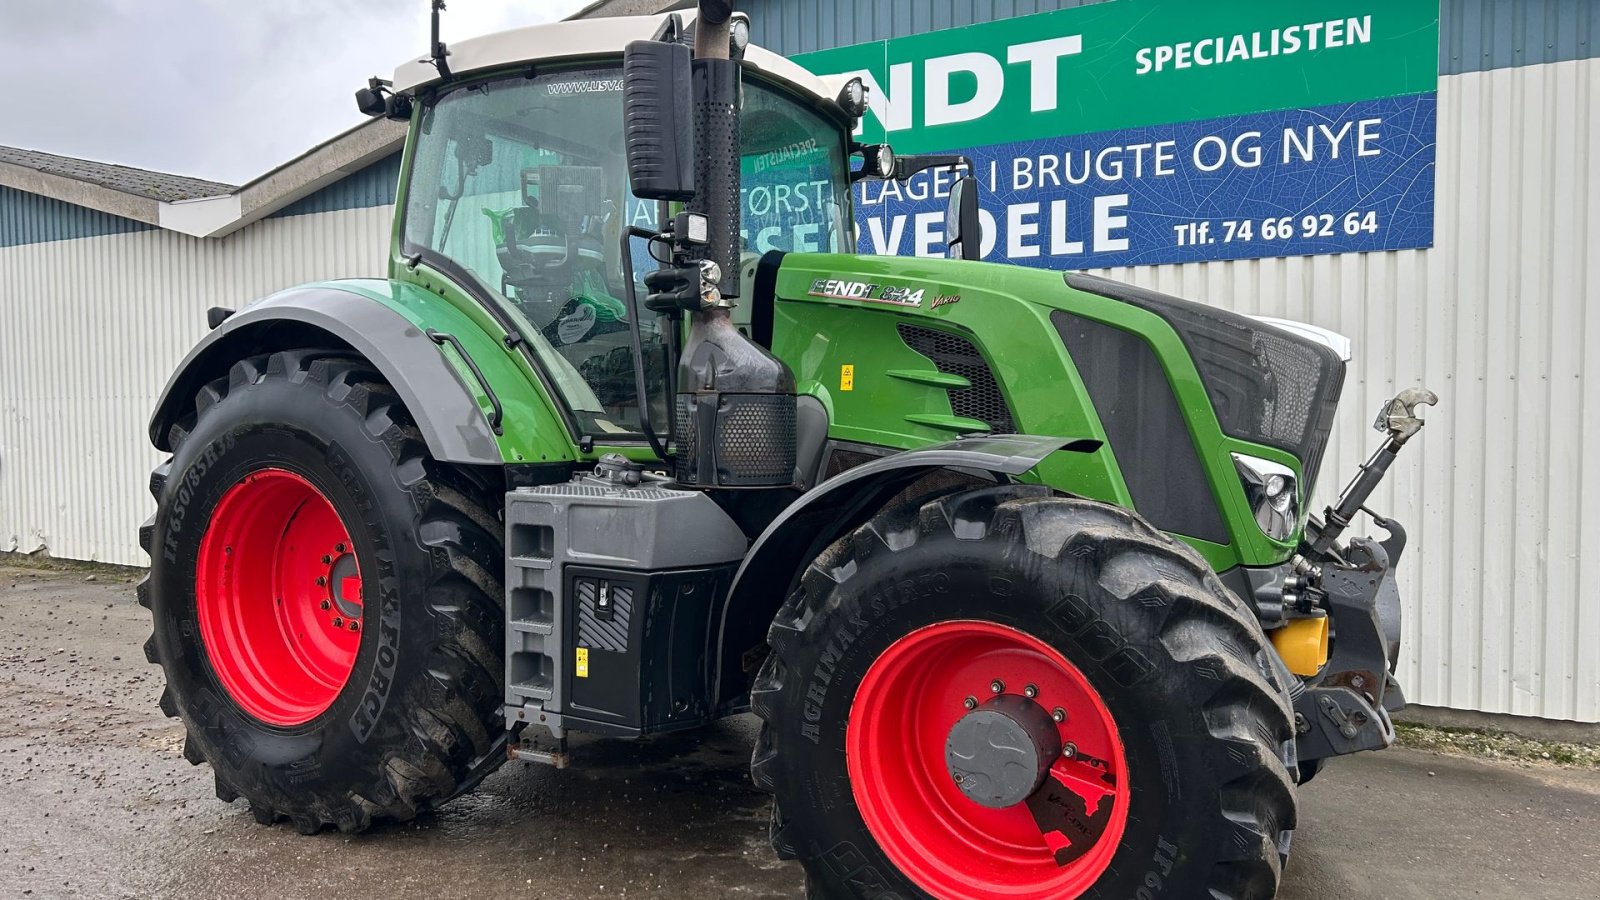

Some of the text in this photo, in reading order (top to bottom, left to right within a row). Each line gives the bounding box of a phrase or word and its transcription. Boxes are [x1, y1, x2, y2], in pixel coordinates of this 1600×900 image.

[1135, 15, 1372, 75] SPECIALISTEN
[850, 34, 1083, 136] NDT
[990, 160, 997, 193] I
[1012, 140, 1176, 190] BRUGTE
[1193, 131, 1262, 172] OG
[1282, 118, 1382, 164] NYE
[1173, 210, 1378, 246] Tlf. 74 66 92 64
[808, 279, 880, 299] FENDT
[879, 285, 926, 305] 824
[352, 619, 399, 738] FORCE
